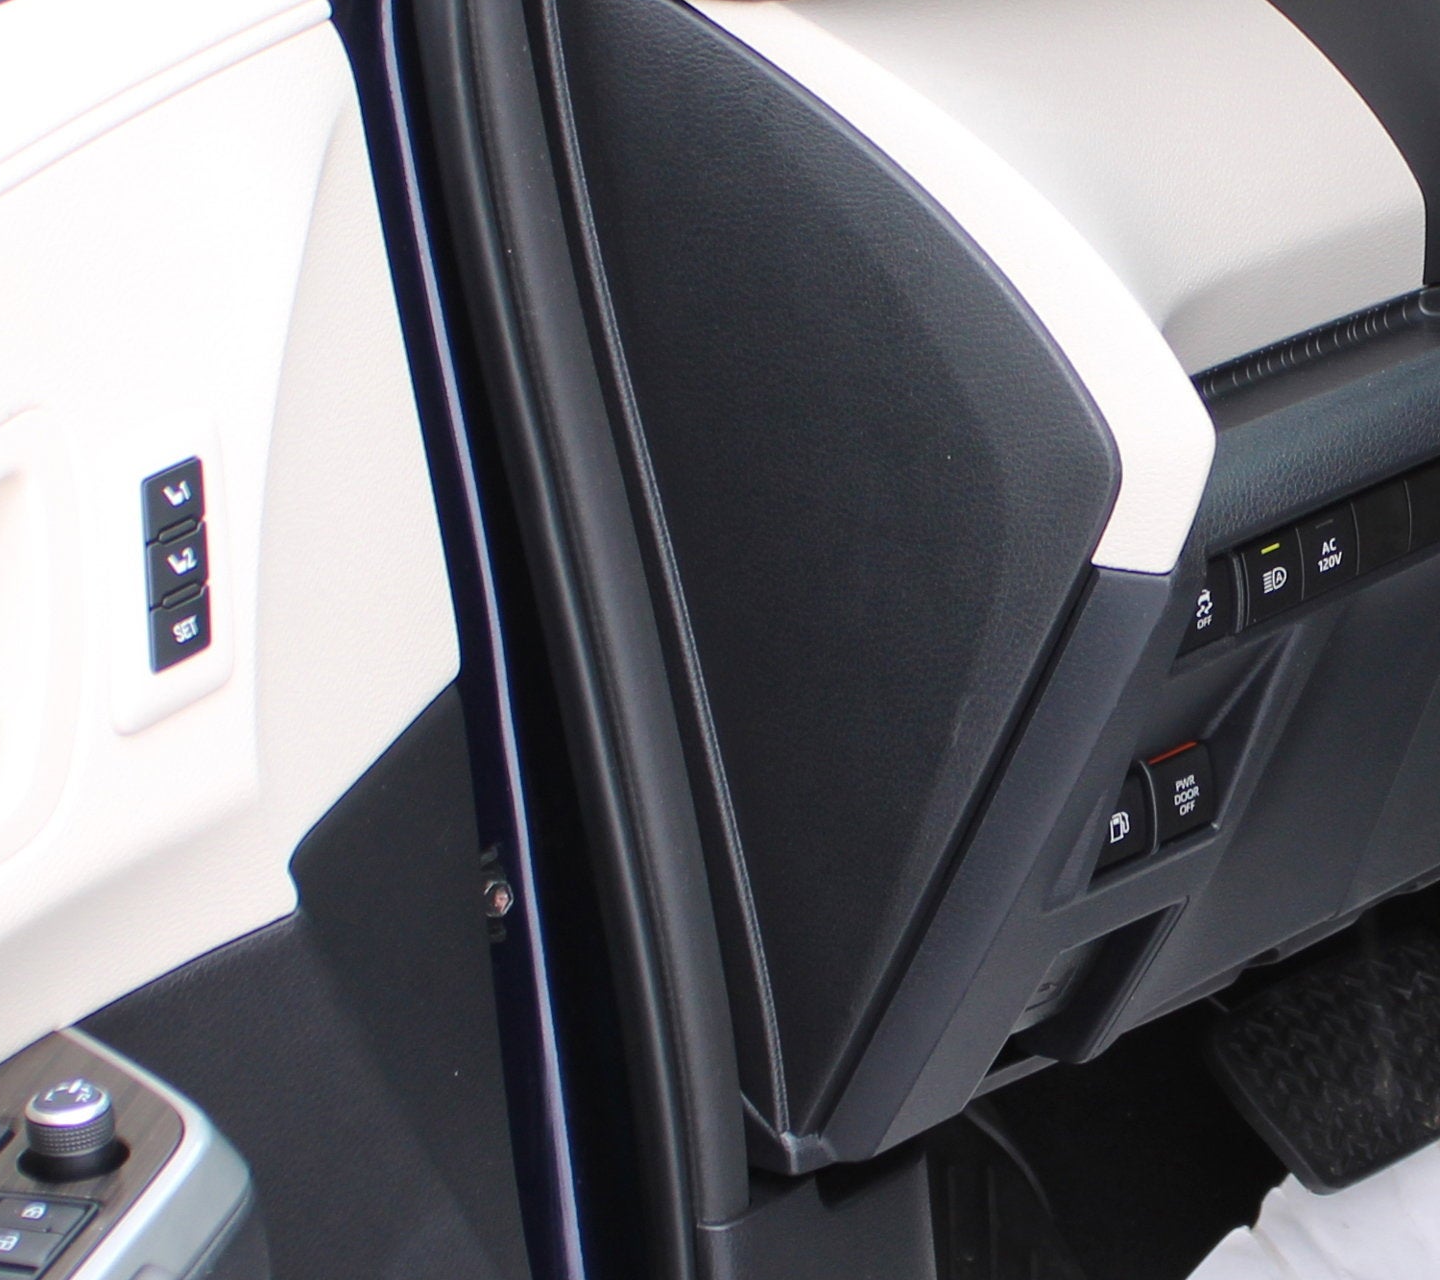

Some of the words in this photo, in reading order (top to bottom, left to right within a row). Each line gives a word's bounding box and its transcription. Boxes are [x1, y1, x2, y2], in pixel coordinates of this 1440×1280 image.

[1321, 536, 1337, 556] AC
[1317, 551, 1343, 572] 120V
[172, 615, 200, 644] SET
[1196, 615, 1213, 630] OFF
[1175, 773, 1196, 792] PWR
[1173, 785, 1200, 807] DOOR
[1179, 800, 1196, 817] OFF
